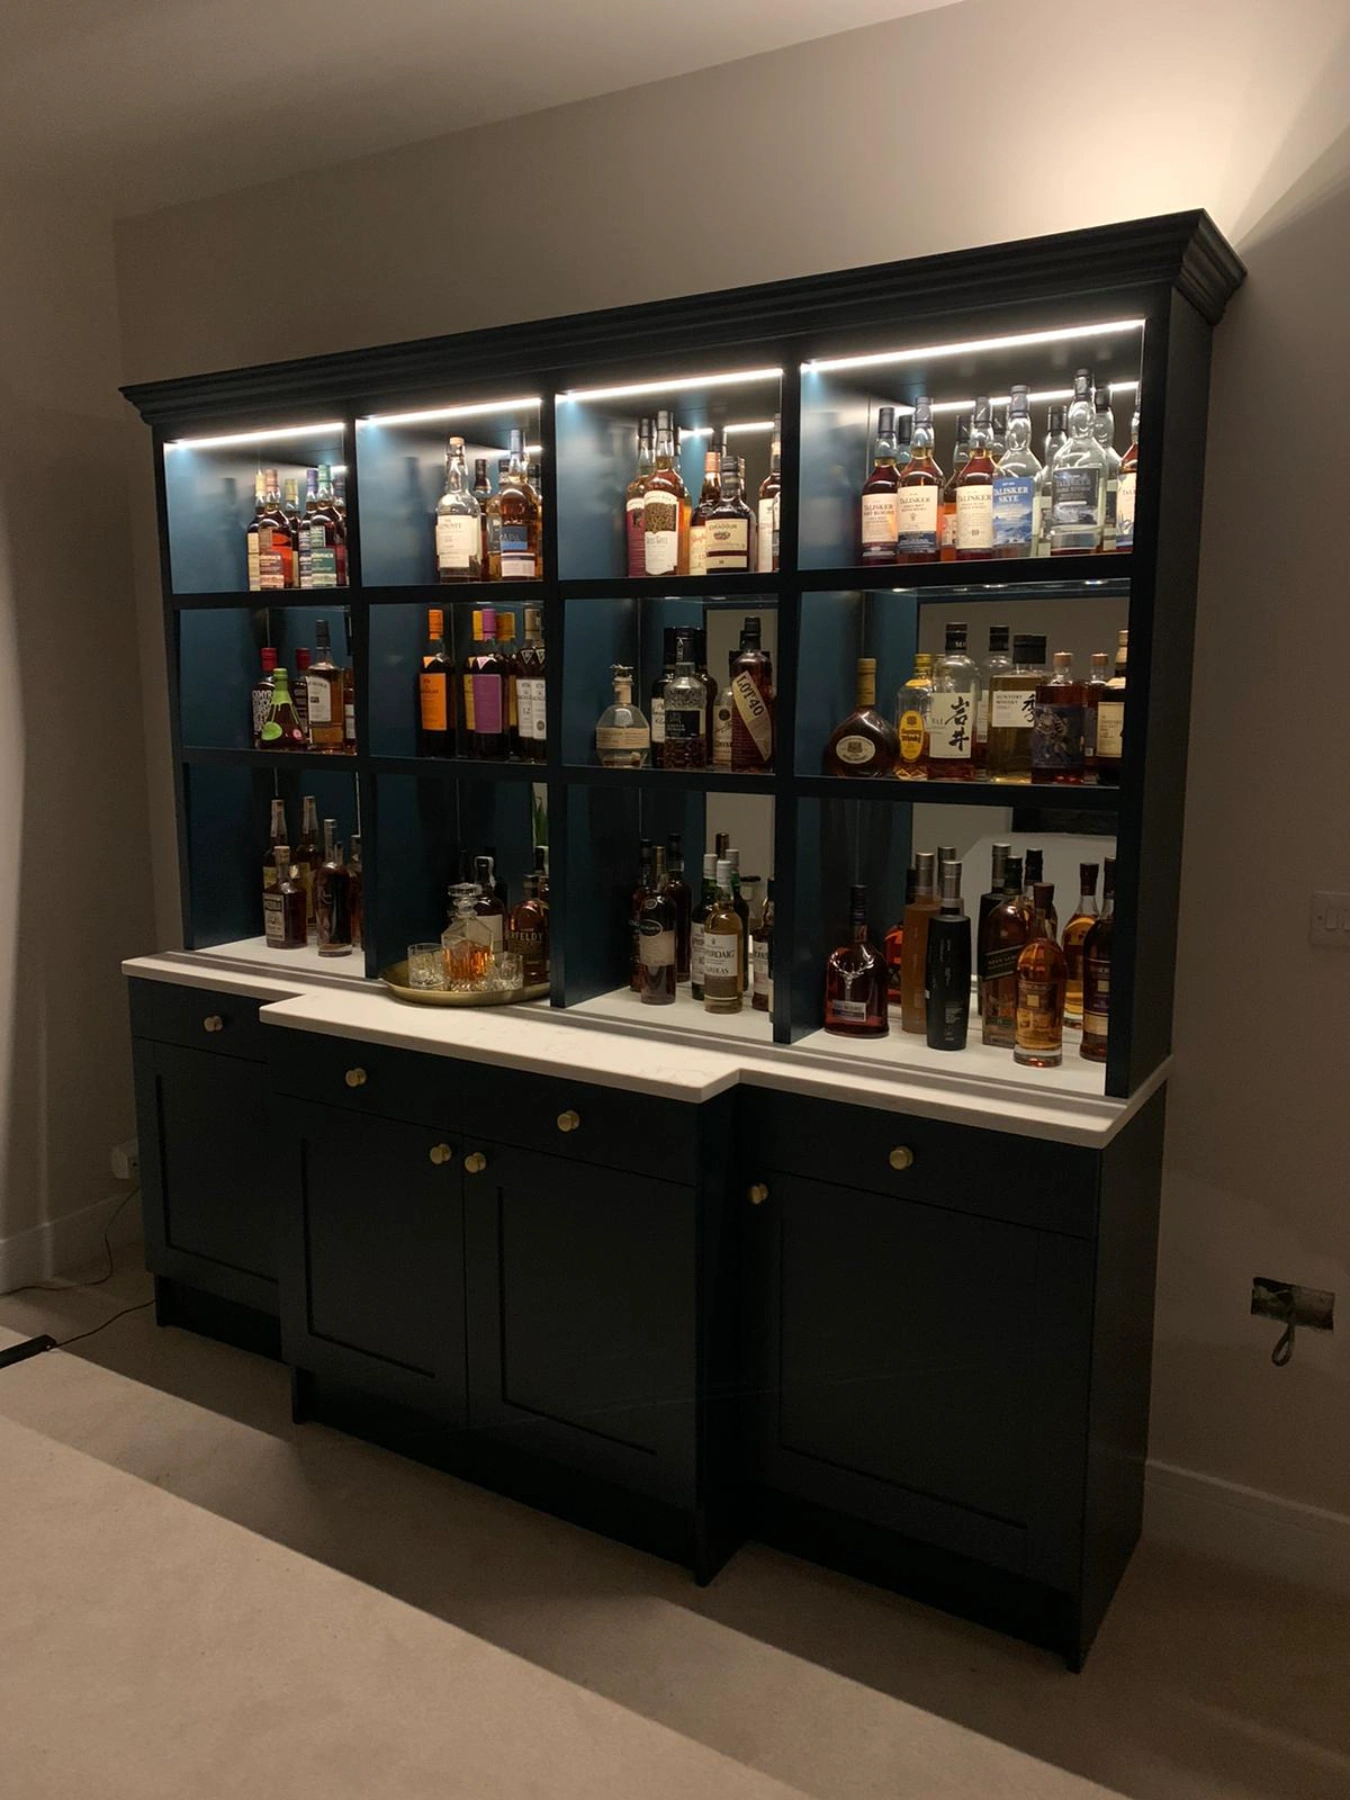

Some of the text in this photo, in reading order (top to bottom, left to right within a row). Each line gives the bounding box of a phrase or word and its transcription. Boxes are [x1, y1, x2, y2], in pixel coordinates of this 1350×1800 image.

[957, 494, 993, 502] TALISKER
[993, 486, 1029, 496] TALISKER
[736, 676, 765, 717] LOT 40
[944, 696, 971, 752] 岩井
